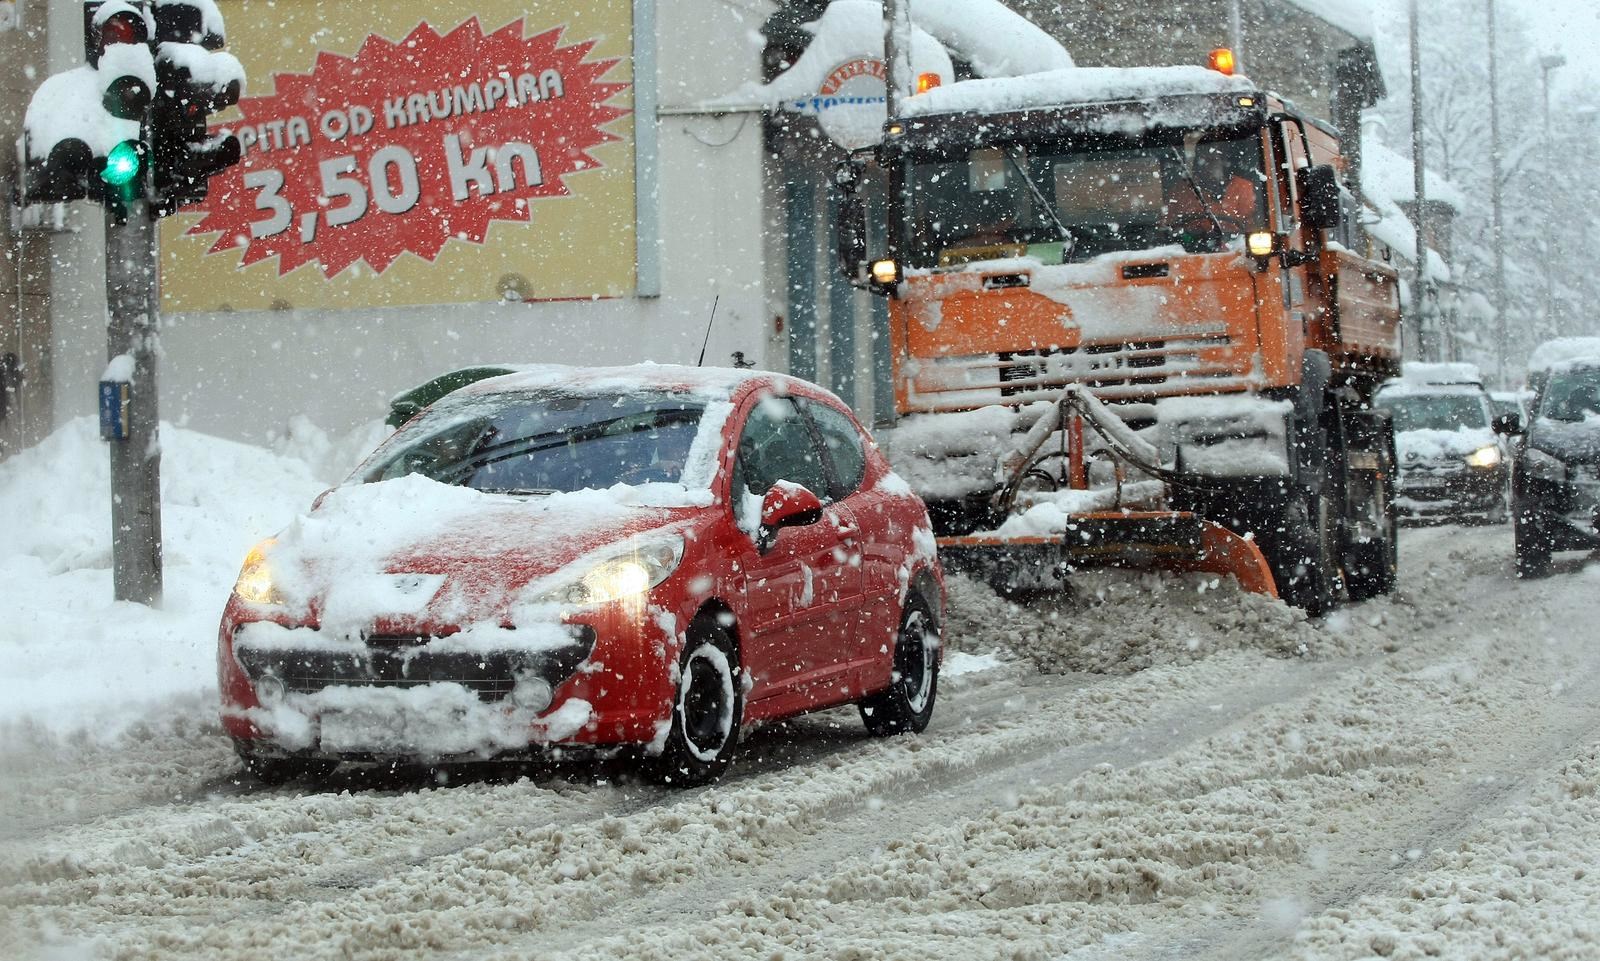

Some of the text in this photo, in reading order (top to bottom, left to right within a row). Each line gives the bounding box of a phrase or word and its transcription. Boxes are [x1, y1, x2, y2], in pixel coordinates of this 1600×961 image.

[238, 68, 565, 157] PITA OD KRUMPIRA
[243, 134, 544, 243] 3,50 kn
